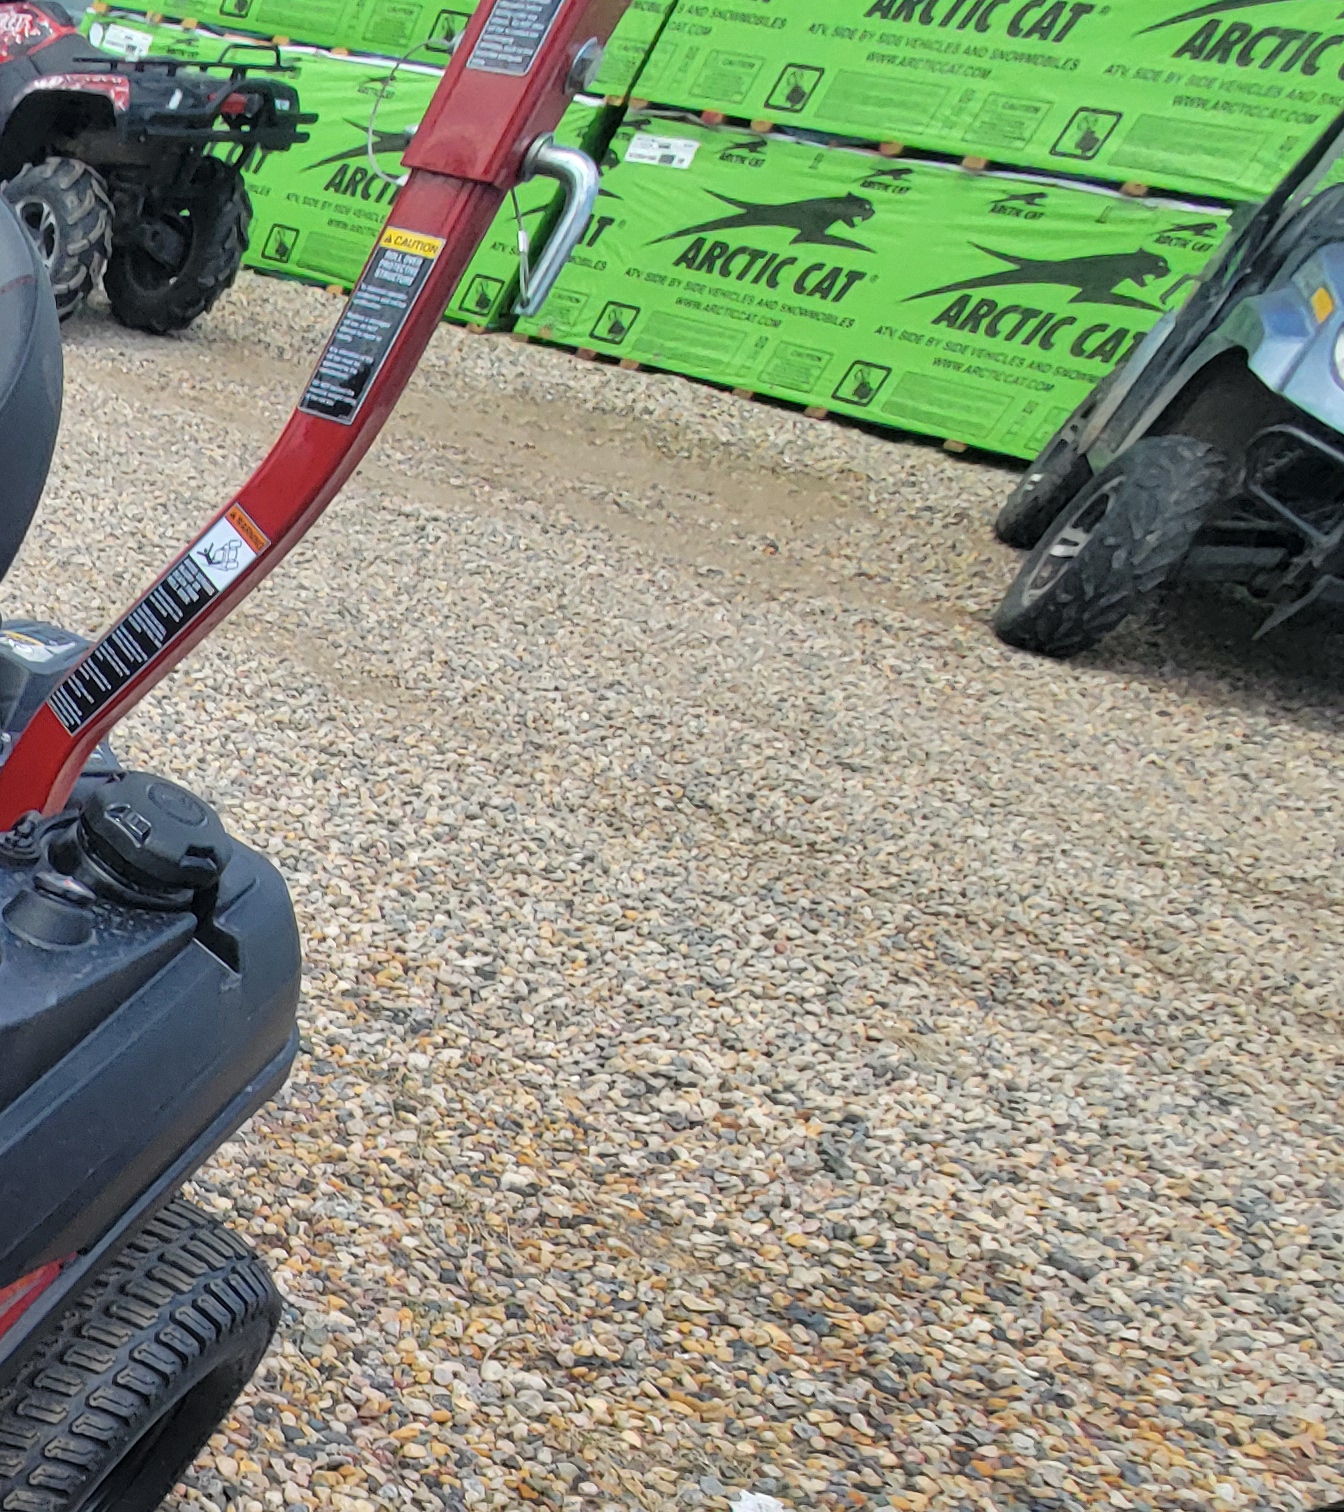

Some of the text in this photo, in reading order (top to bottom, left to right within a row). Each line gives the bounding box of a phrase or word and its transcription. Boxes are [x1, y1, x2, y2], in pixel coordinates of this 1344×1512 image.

[1171, 18, 1344, 76] ARCTIC
[394, 235, 439, 254] CAUTION
[672, 236, 868, 302] ARCTIC CAT
[931, 294, 1077, 350] ARCTIC
